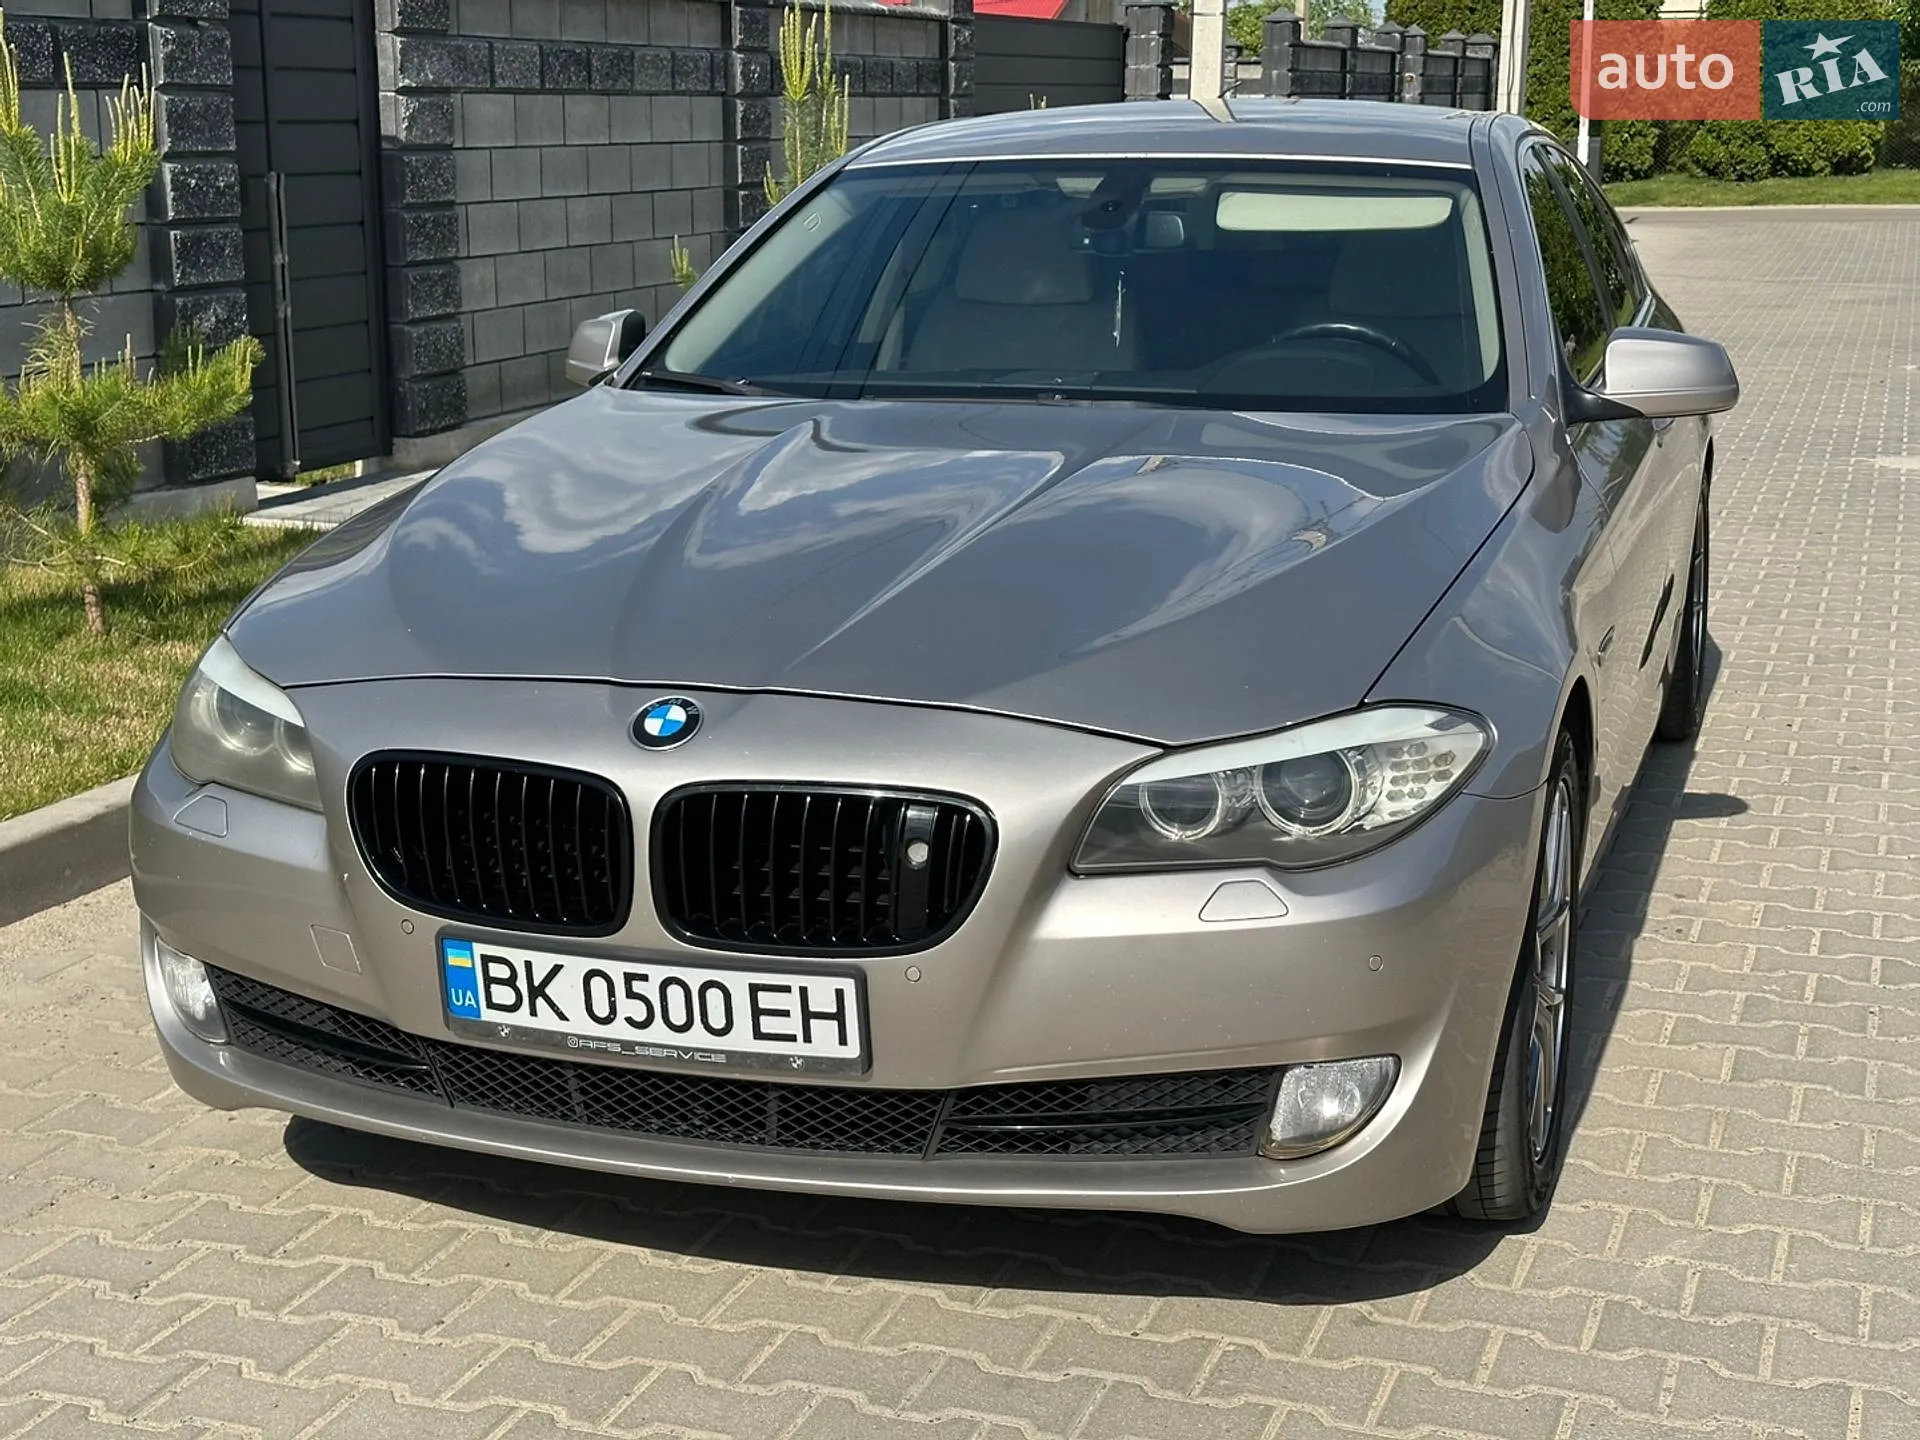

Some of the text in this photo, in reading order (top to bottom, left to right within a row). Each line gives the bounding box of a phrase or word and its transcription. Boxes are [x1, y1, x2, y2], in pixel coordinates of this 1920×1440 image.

[451, 988, 478, 1009] UA
[479, 953, 849, 1047] BK 0500 EH
